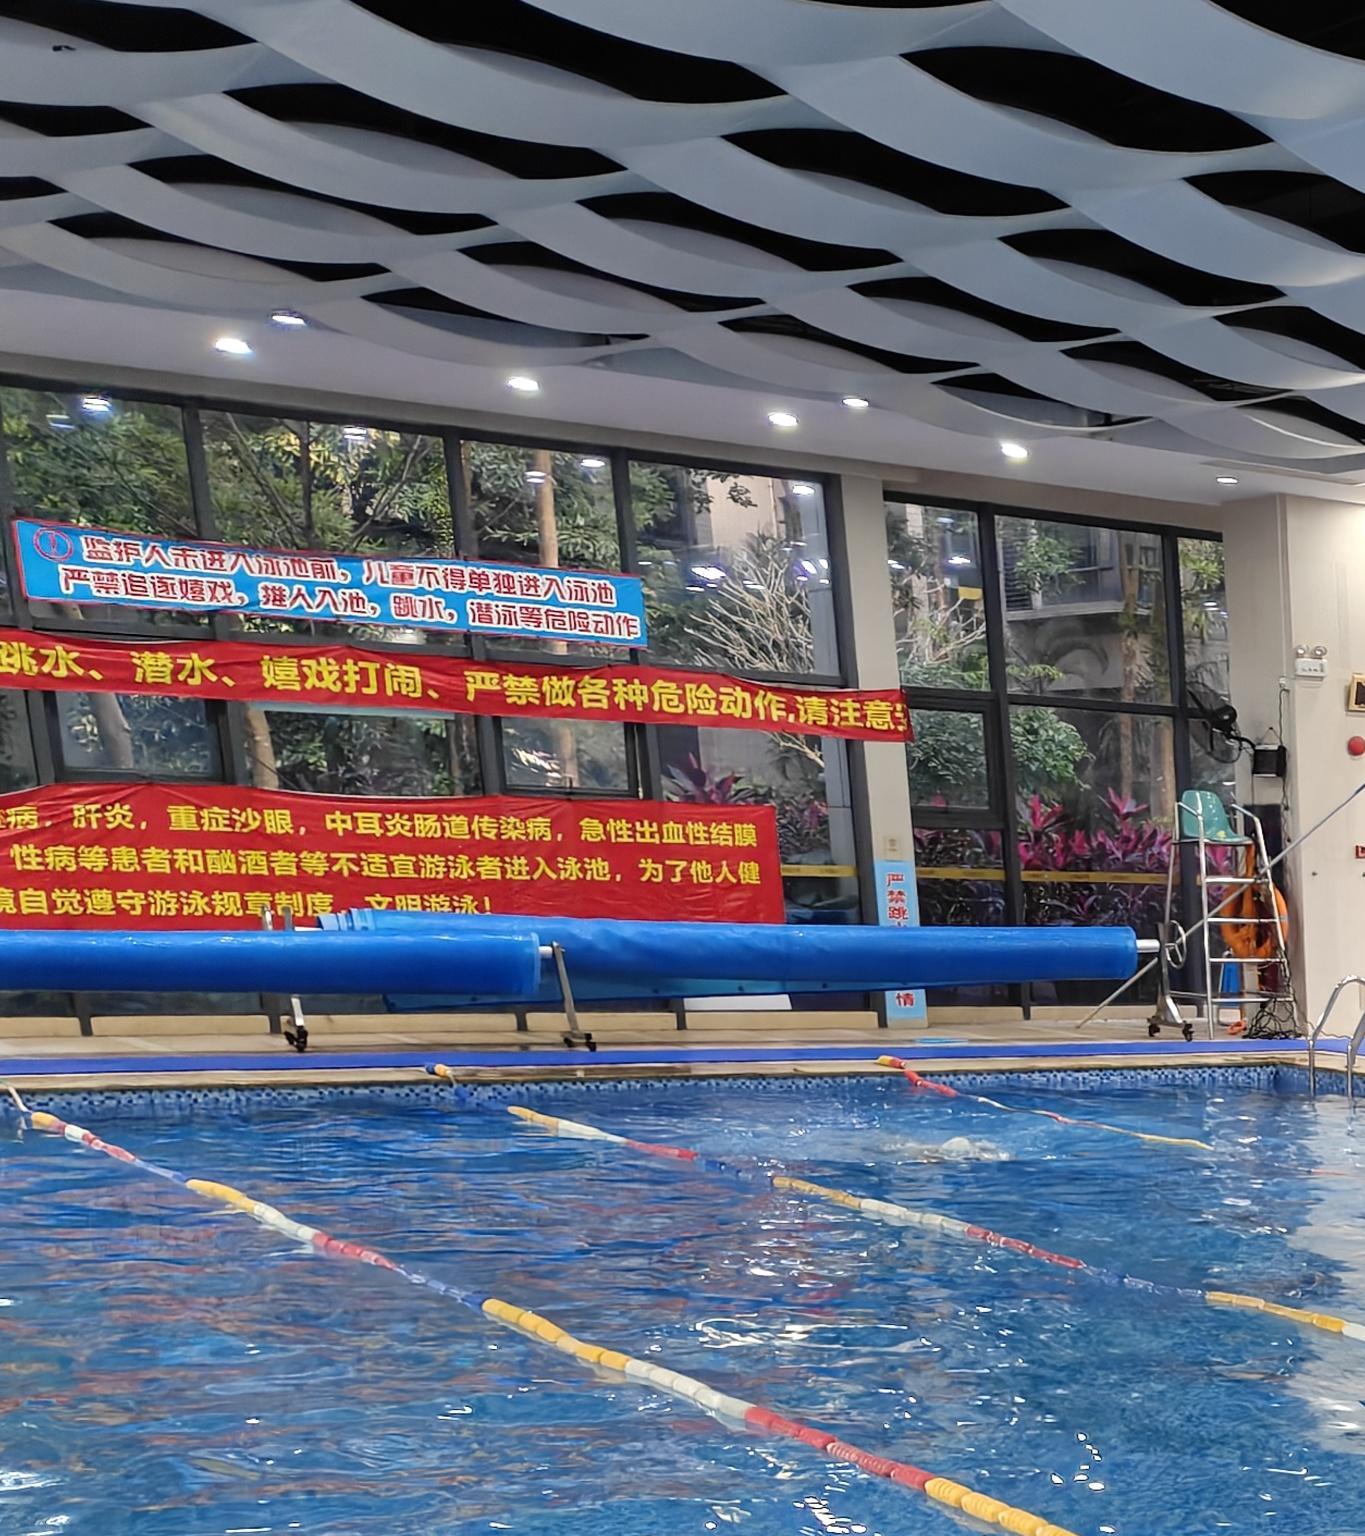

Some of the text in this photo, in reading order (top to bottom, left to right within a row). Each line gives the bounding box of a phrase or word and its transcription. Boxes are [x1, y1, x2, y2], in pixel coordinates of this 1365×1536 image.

[0, 803, 757, 847] 病，肝炎，重症沙眼，中耳炎肠道传染病，急性出血性结膜
[887, 873, 908, 927] 严禁跳
